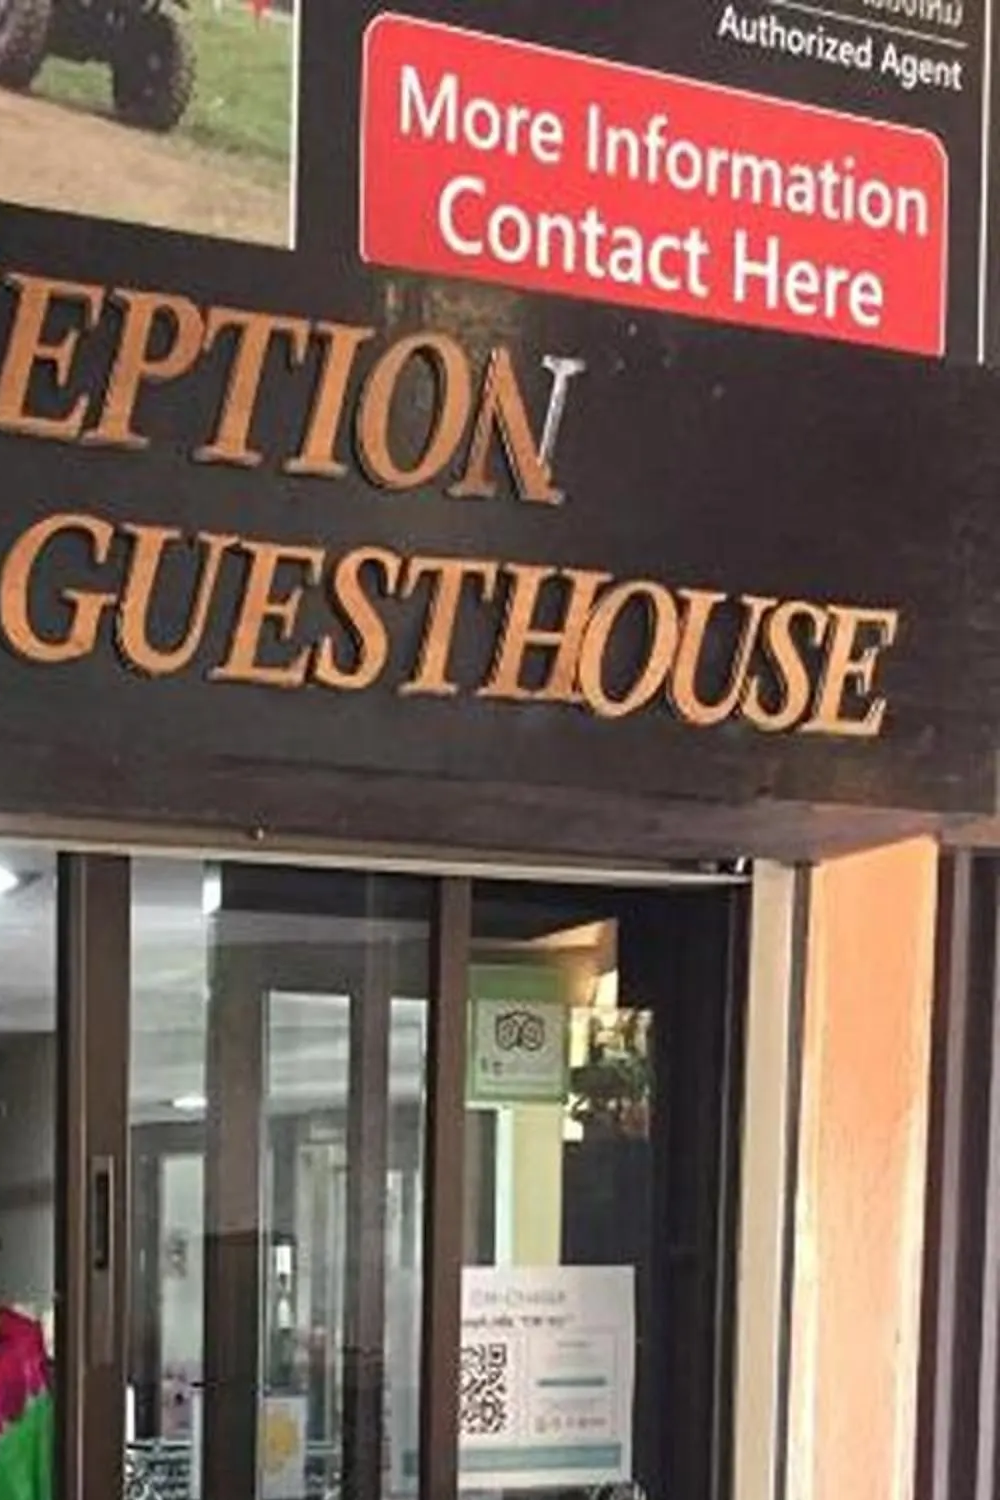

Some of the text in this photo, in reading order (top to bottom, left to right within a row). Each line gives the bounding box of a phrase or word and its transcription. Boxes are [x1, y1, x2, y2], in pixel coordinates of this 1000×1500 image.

[717, 4, 873, 69] Authorized
[880, 42, 962, 91] Agent
[399, 65, 929, 236] More Information
[438, 176, 884, 327] Contact Here
